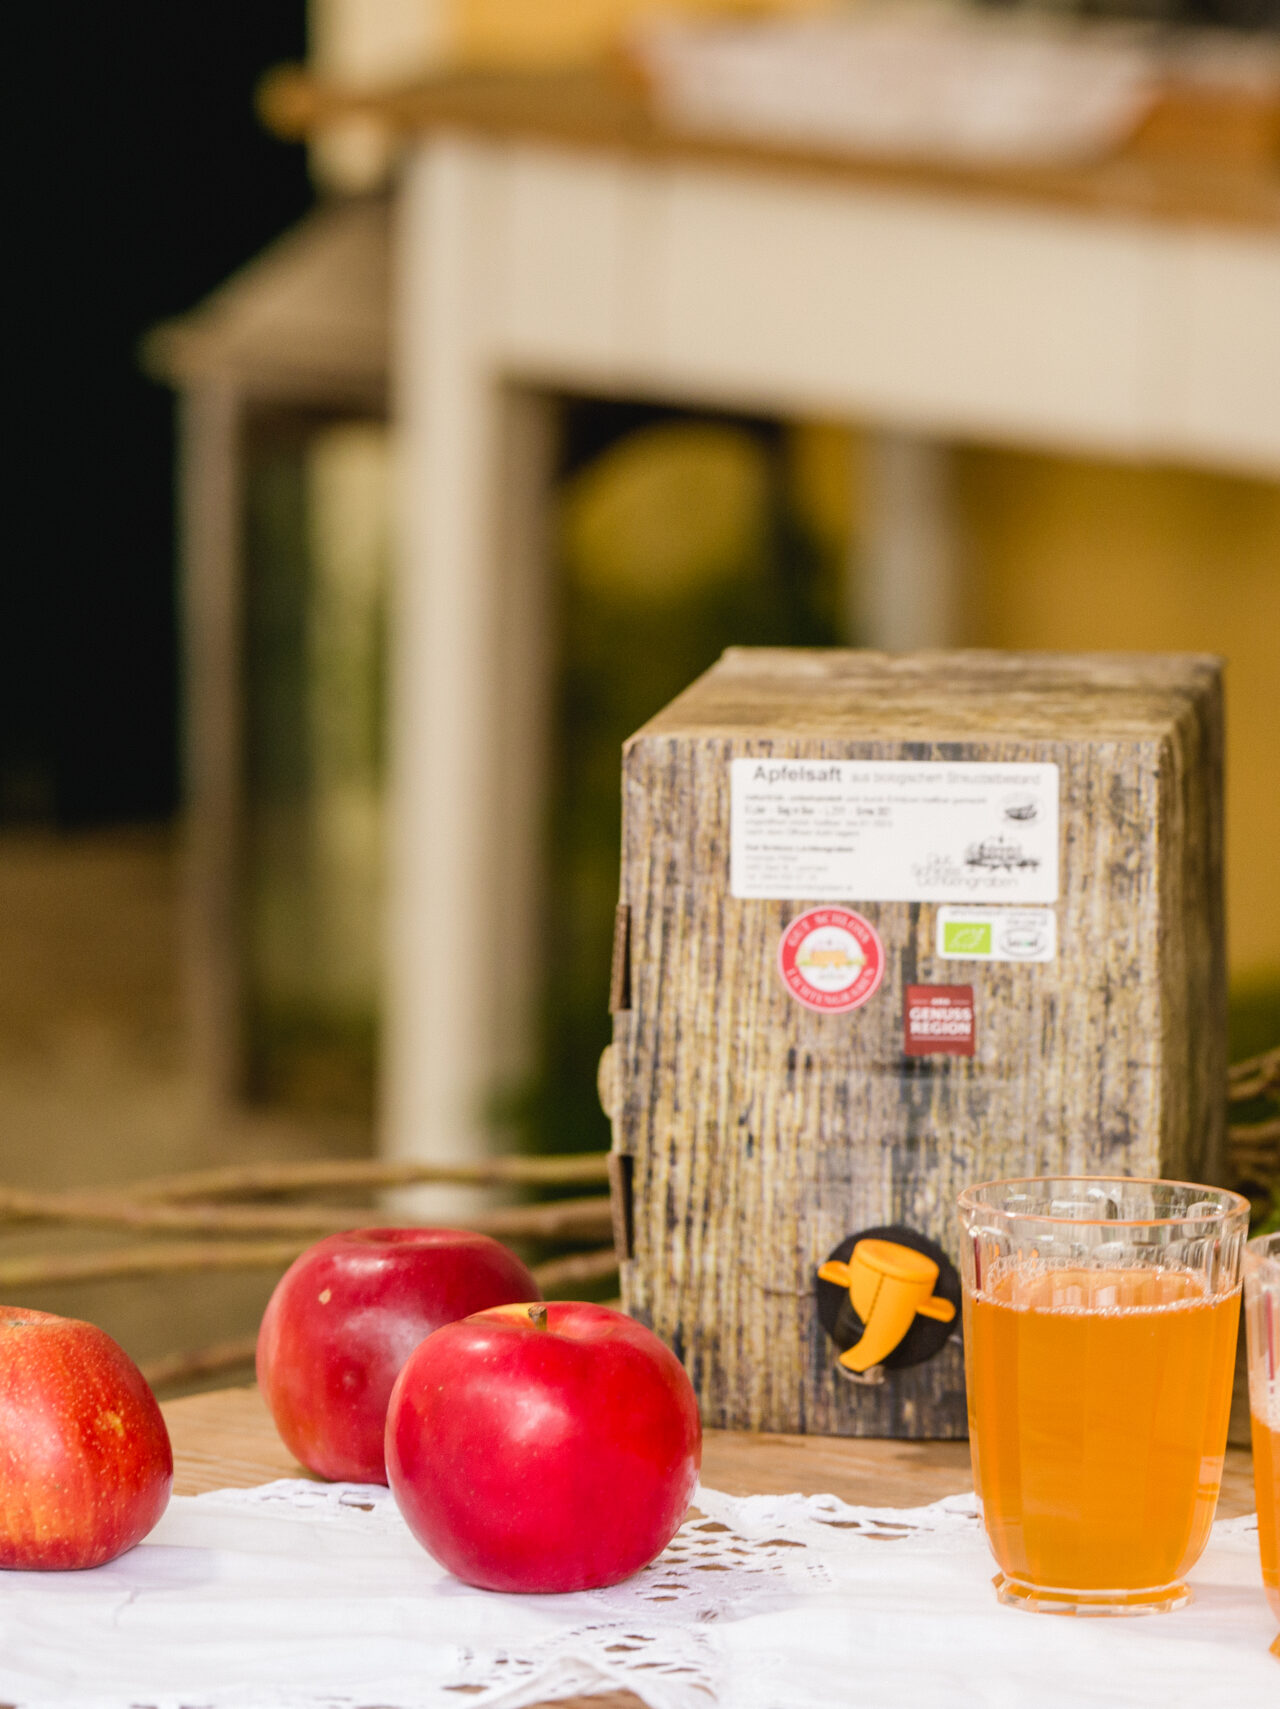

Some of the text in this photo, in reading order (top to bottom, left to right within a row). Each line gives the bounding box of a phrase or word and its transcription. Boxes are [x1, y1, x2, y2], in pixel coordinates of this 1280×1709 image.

[753, 765, 842, 784] Apfelsaft
[909, 1006, 972, 1021] GENUSS
[910, 1020, 972, 1035] REGION
